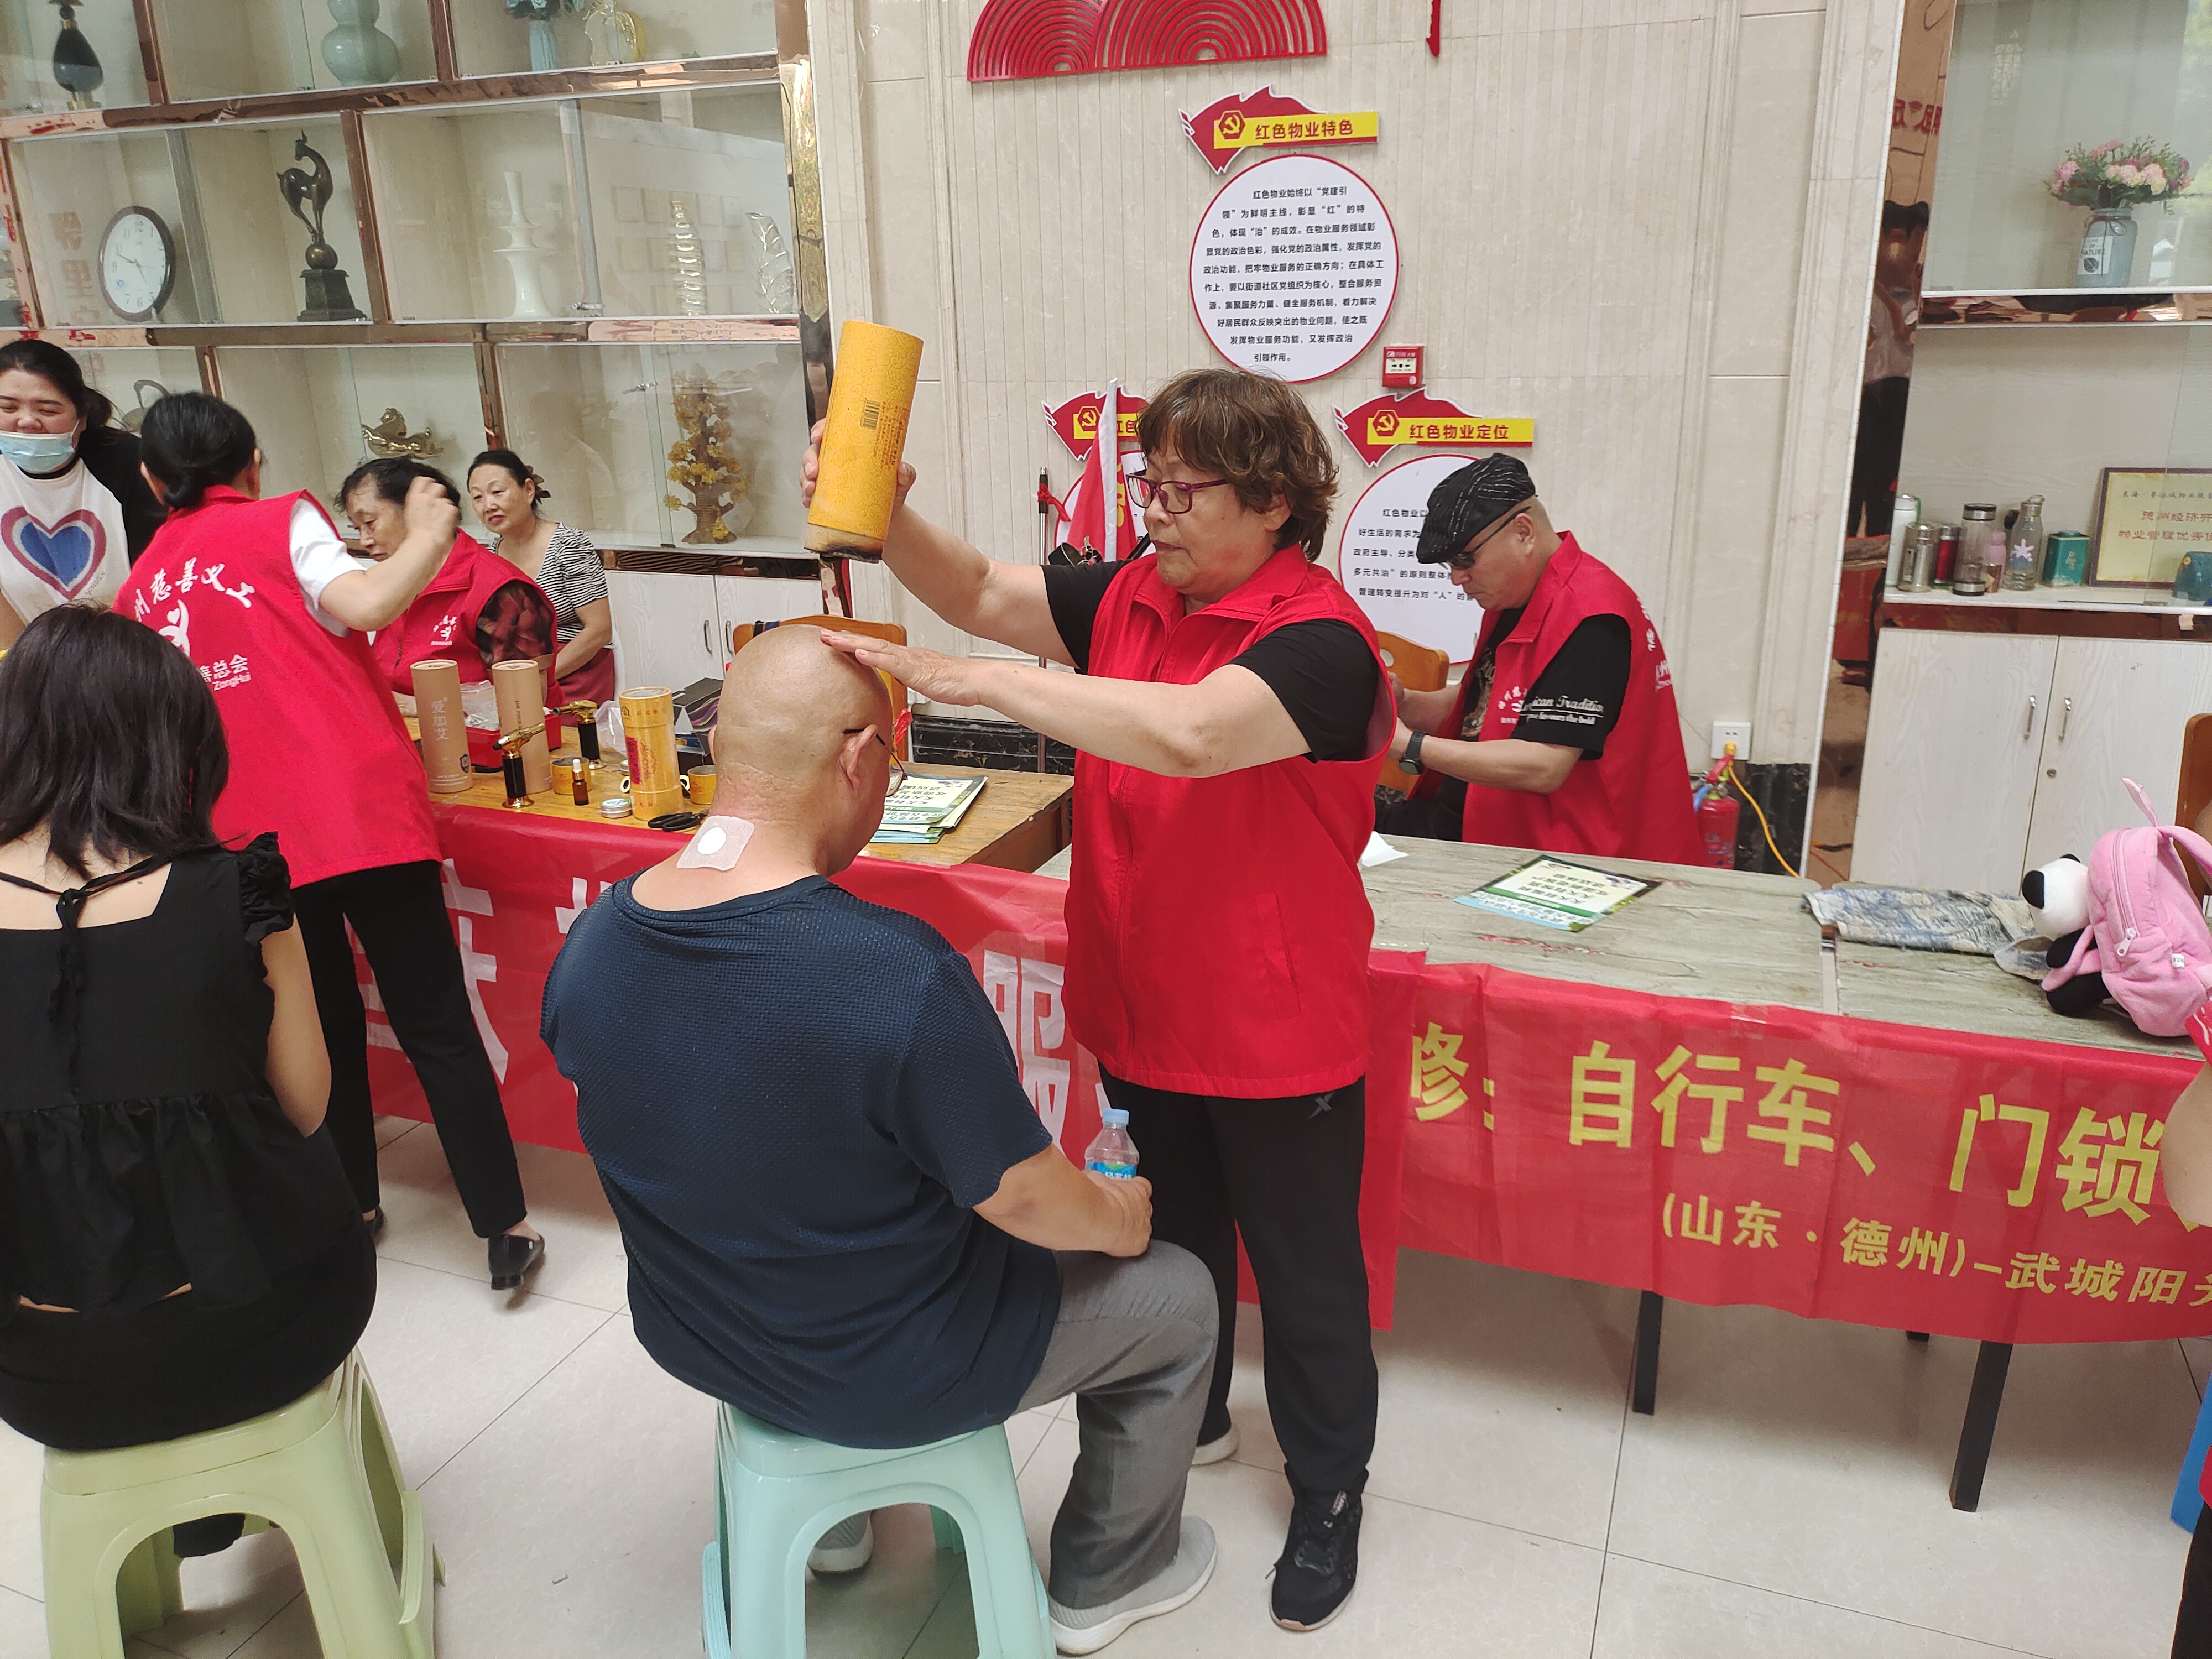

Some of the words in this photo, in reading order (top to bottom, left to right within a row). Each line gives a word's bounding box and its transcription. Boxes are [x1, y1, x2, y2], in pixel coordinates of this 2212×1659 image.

[1255, 118, 1354, 140] 红色物业特色
[1253, 186, 1348, 200] 红色物业始终以“党建引
[1230, 334, 1353, 345] 发挥物业服务功能，又发挥政治
[1254, 353, 1292, 362] 引领作用。
[1409, 424, 1509, 440] 红色物业定位
[1358, 528, 1421, 539] 好生活的需求为
[1353, 548, 1415, 559] 政府主导、分类
